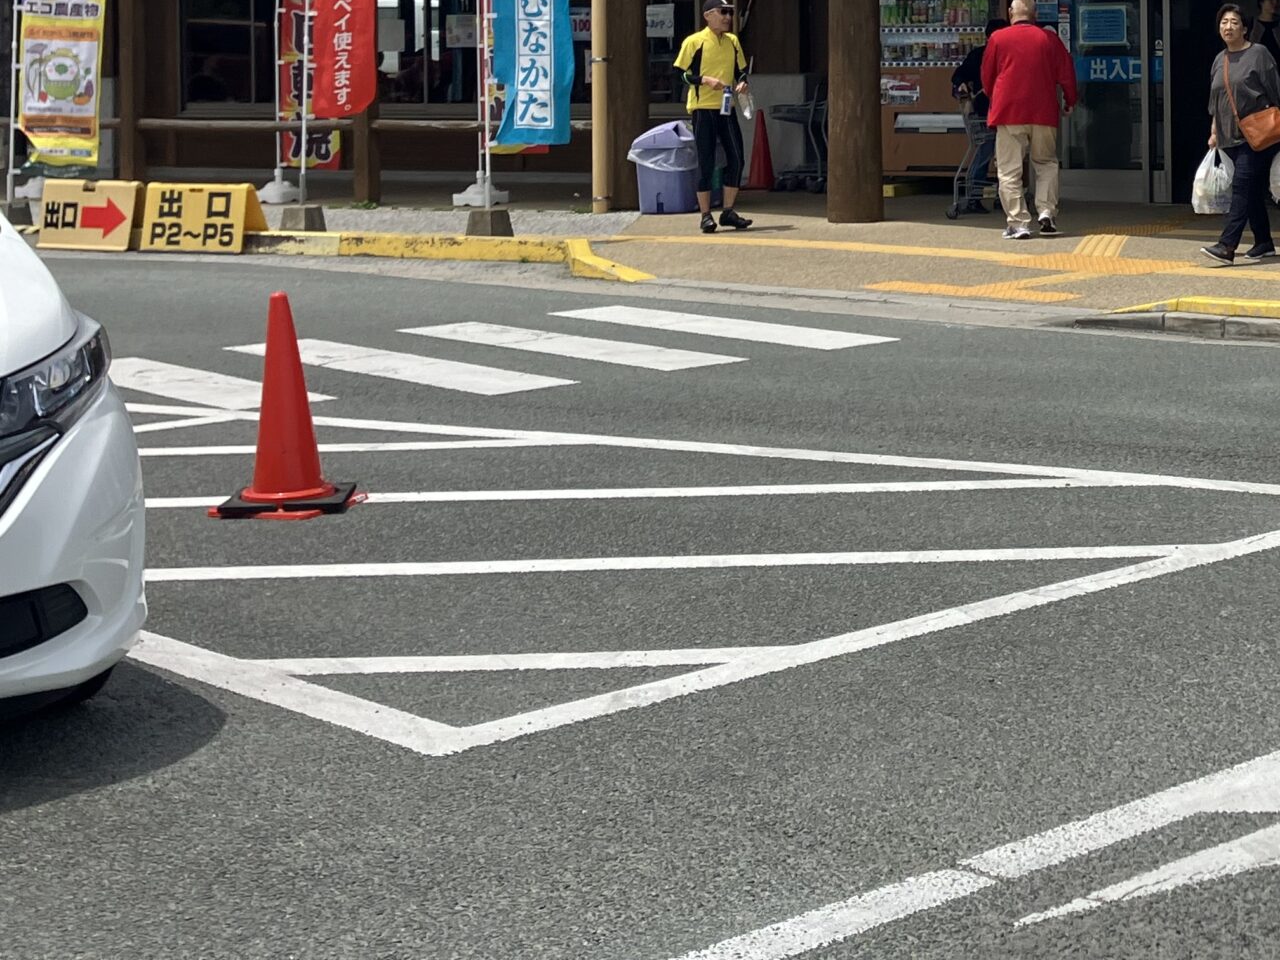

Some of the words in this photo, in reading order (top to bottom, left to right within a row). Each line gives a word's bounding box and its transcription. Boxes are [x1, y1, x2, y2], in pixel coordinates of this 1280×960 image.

[25, 1, 99, 17] エコ農産物
[1090, 57, 1142, 80] 出入口
[44, 201, 79, 230] 出口
[159, 189, 232, 219] 出口
